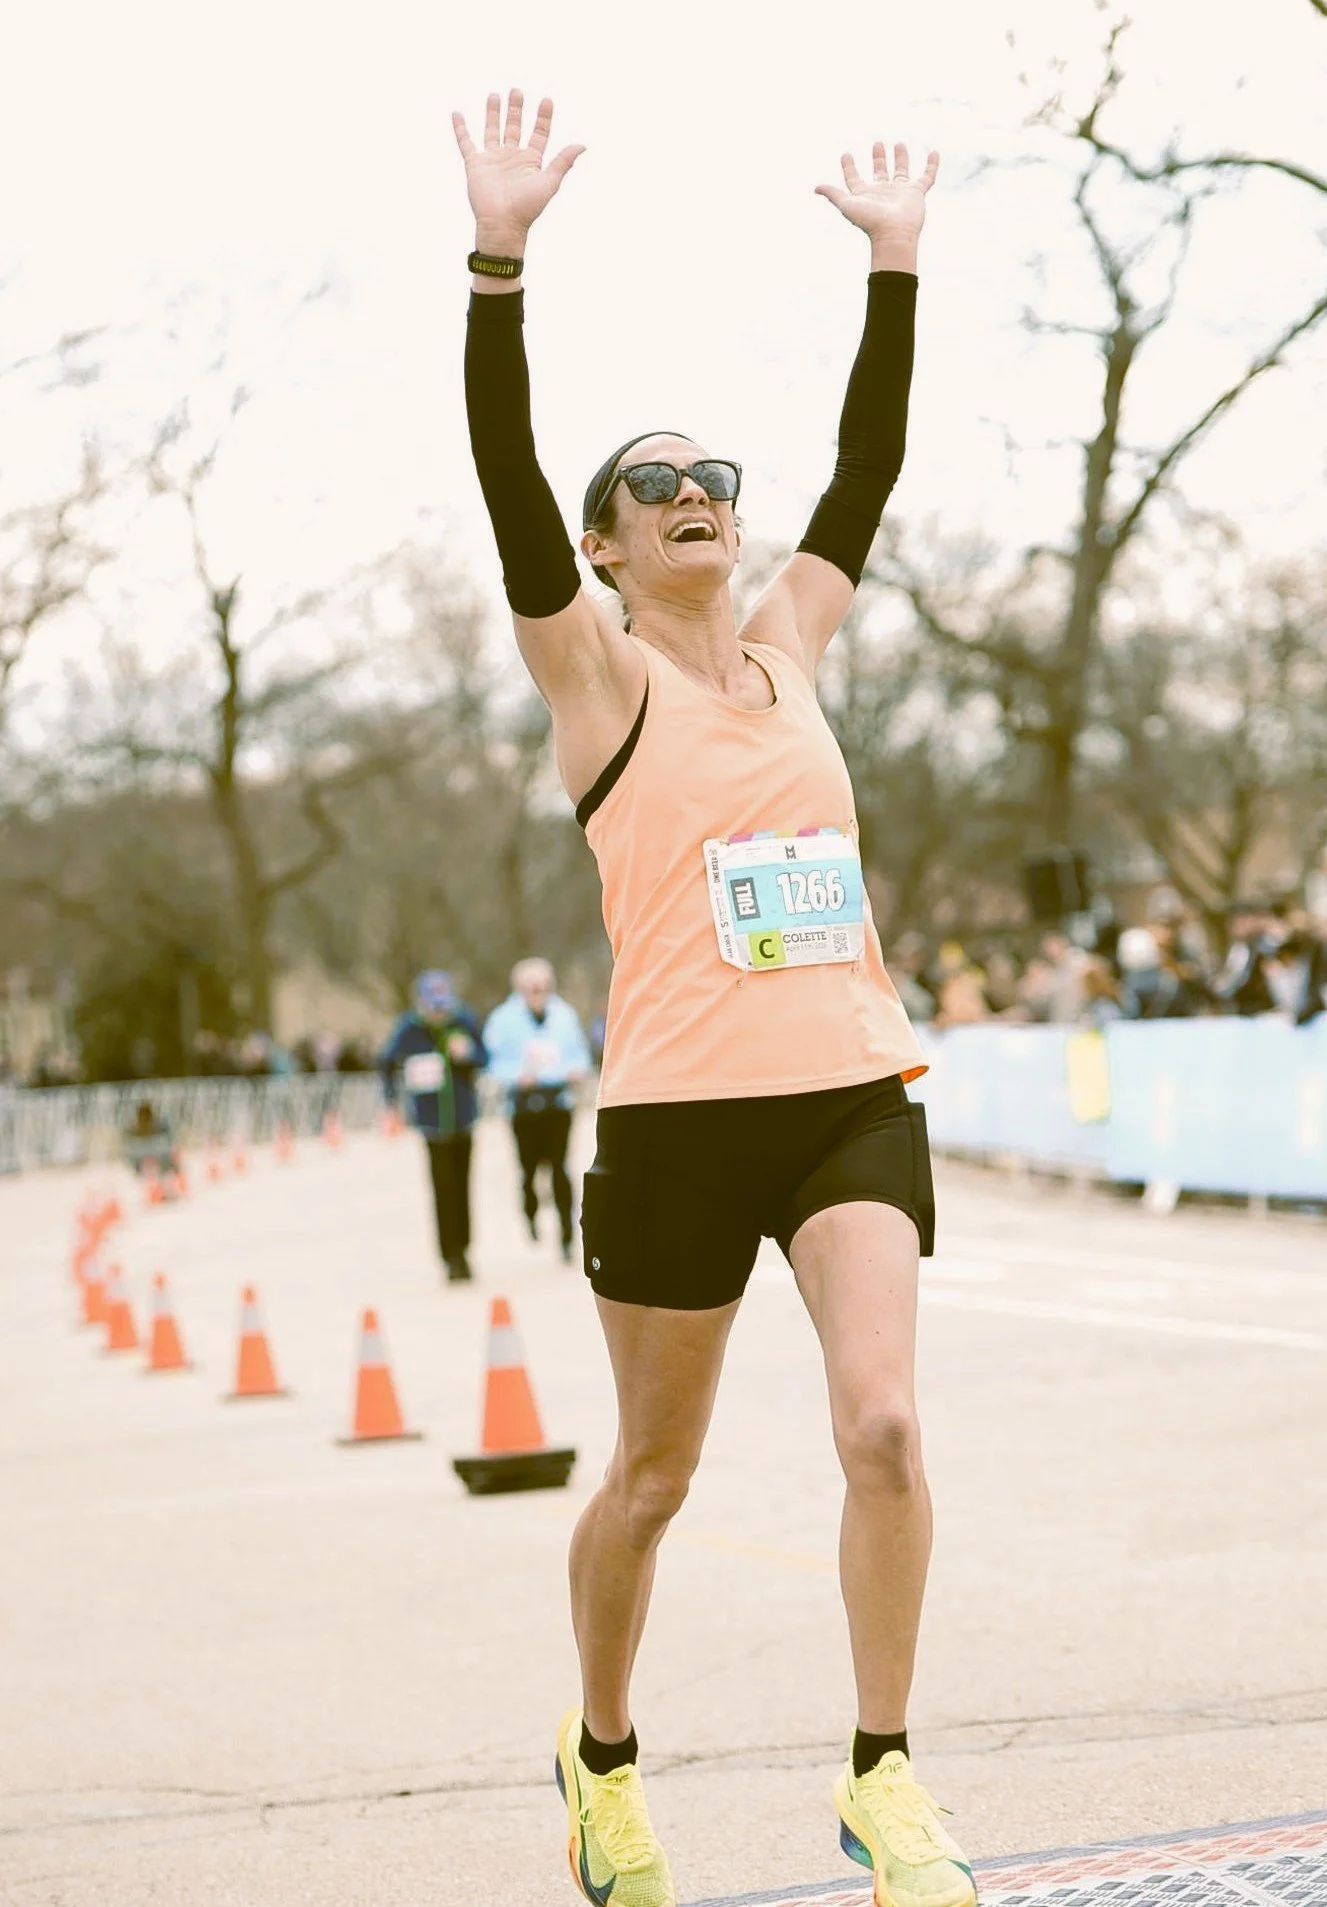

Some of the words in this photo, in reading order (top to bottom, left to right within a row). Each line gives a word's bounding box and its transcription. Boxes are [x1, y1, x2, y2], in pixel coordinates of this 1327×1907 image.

[734, 882, 757, 916] FULL
[776, 868, 846, 915] 1266
[758, 938, 775, 959] C
[783, 931, 827, 944] COLETTE
